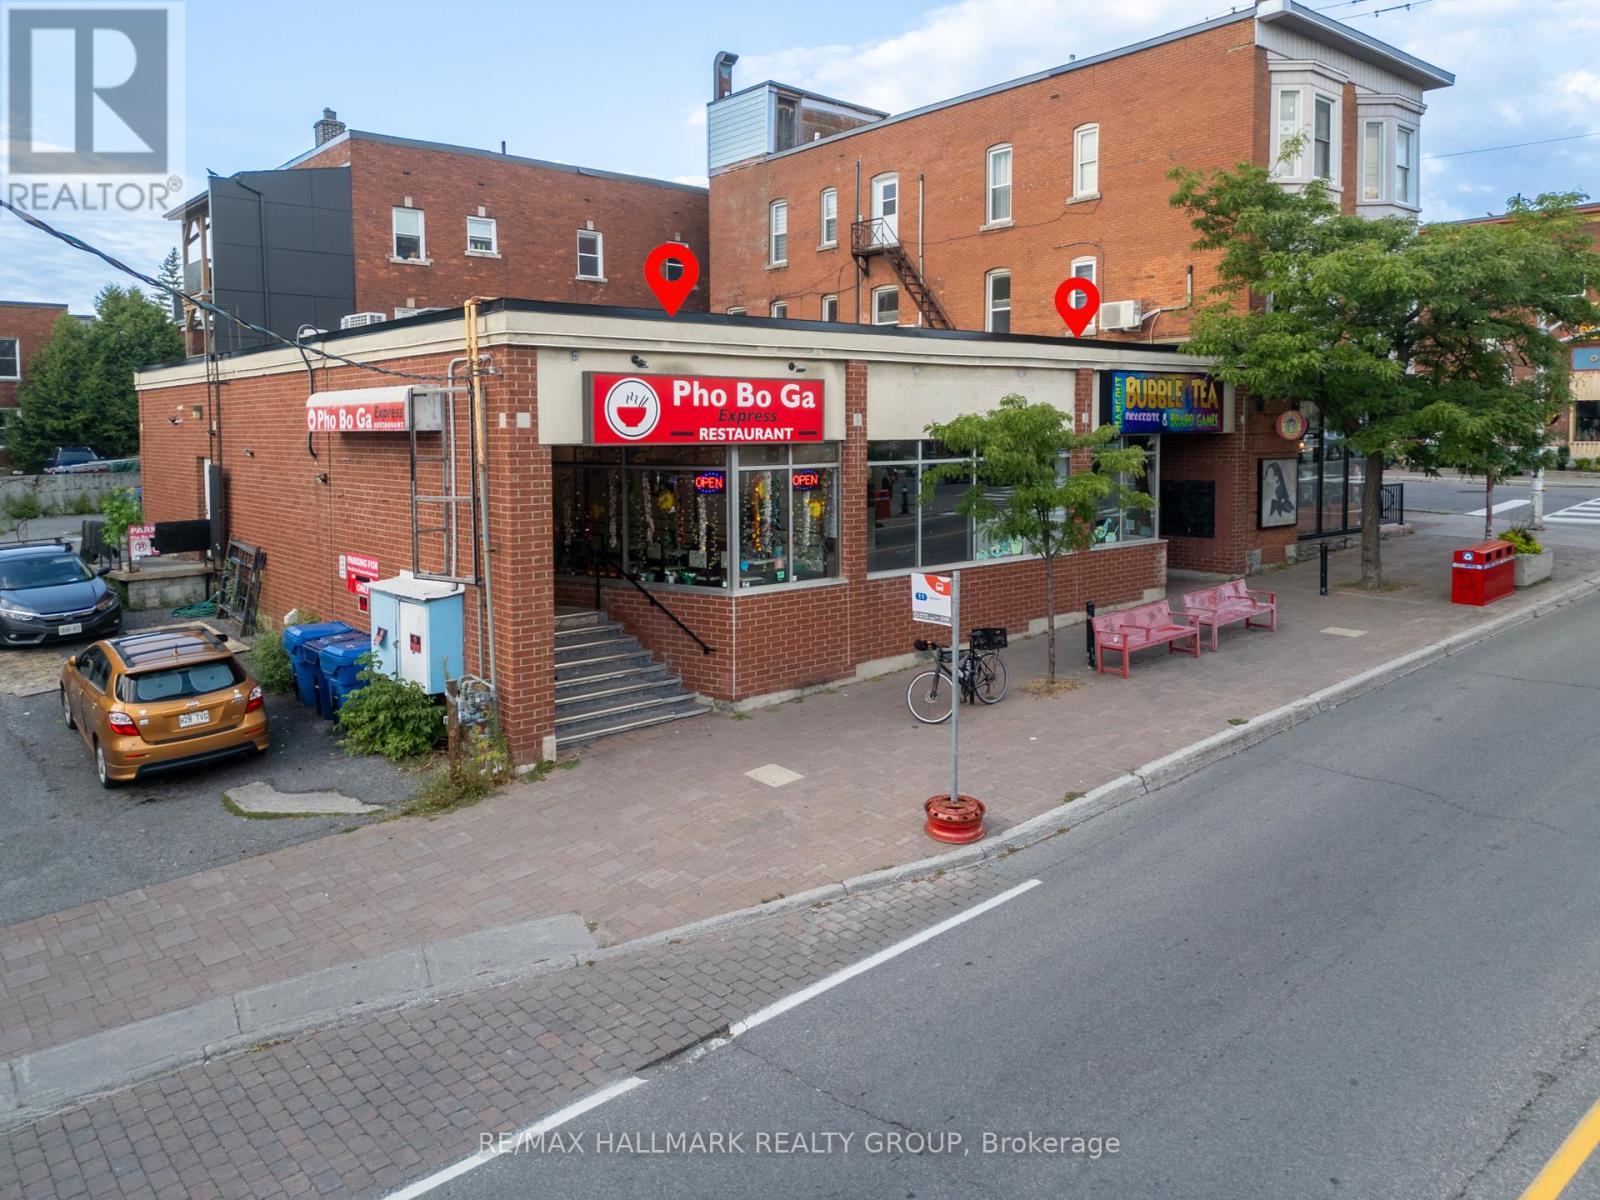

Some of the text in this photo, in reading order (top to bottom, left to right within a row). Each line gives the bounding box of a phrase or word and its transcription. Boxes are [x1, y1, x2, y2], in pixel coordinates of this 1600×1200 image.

[673, 380, 816, 409] Pho Bo Ga
[1125, 376, 1219, 409] BUBBLE TEA
[317, 407, 372, 430] Pho Bo Ga
[374, 406, 404, 420] Express
[718, 408, 777, 425] Express
[1162, 412, 1168, 427] &
[699, 427, 793, 441] RESTAURANT
[695, 476, 723, 489] OPEN
[791, 474, 818, 486] OPEN
